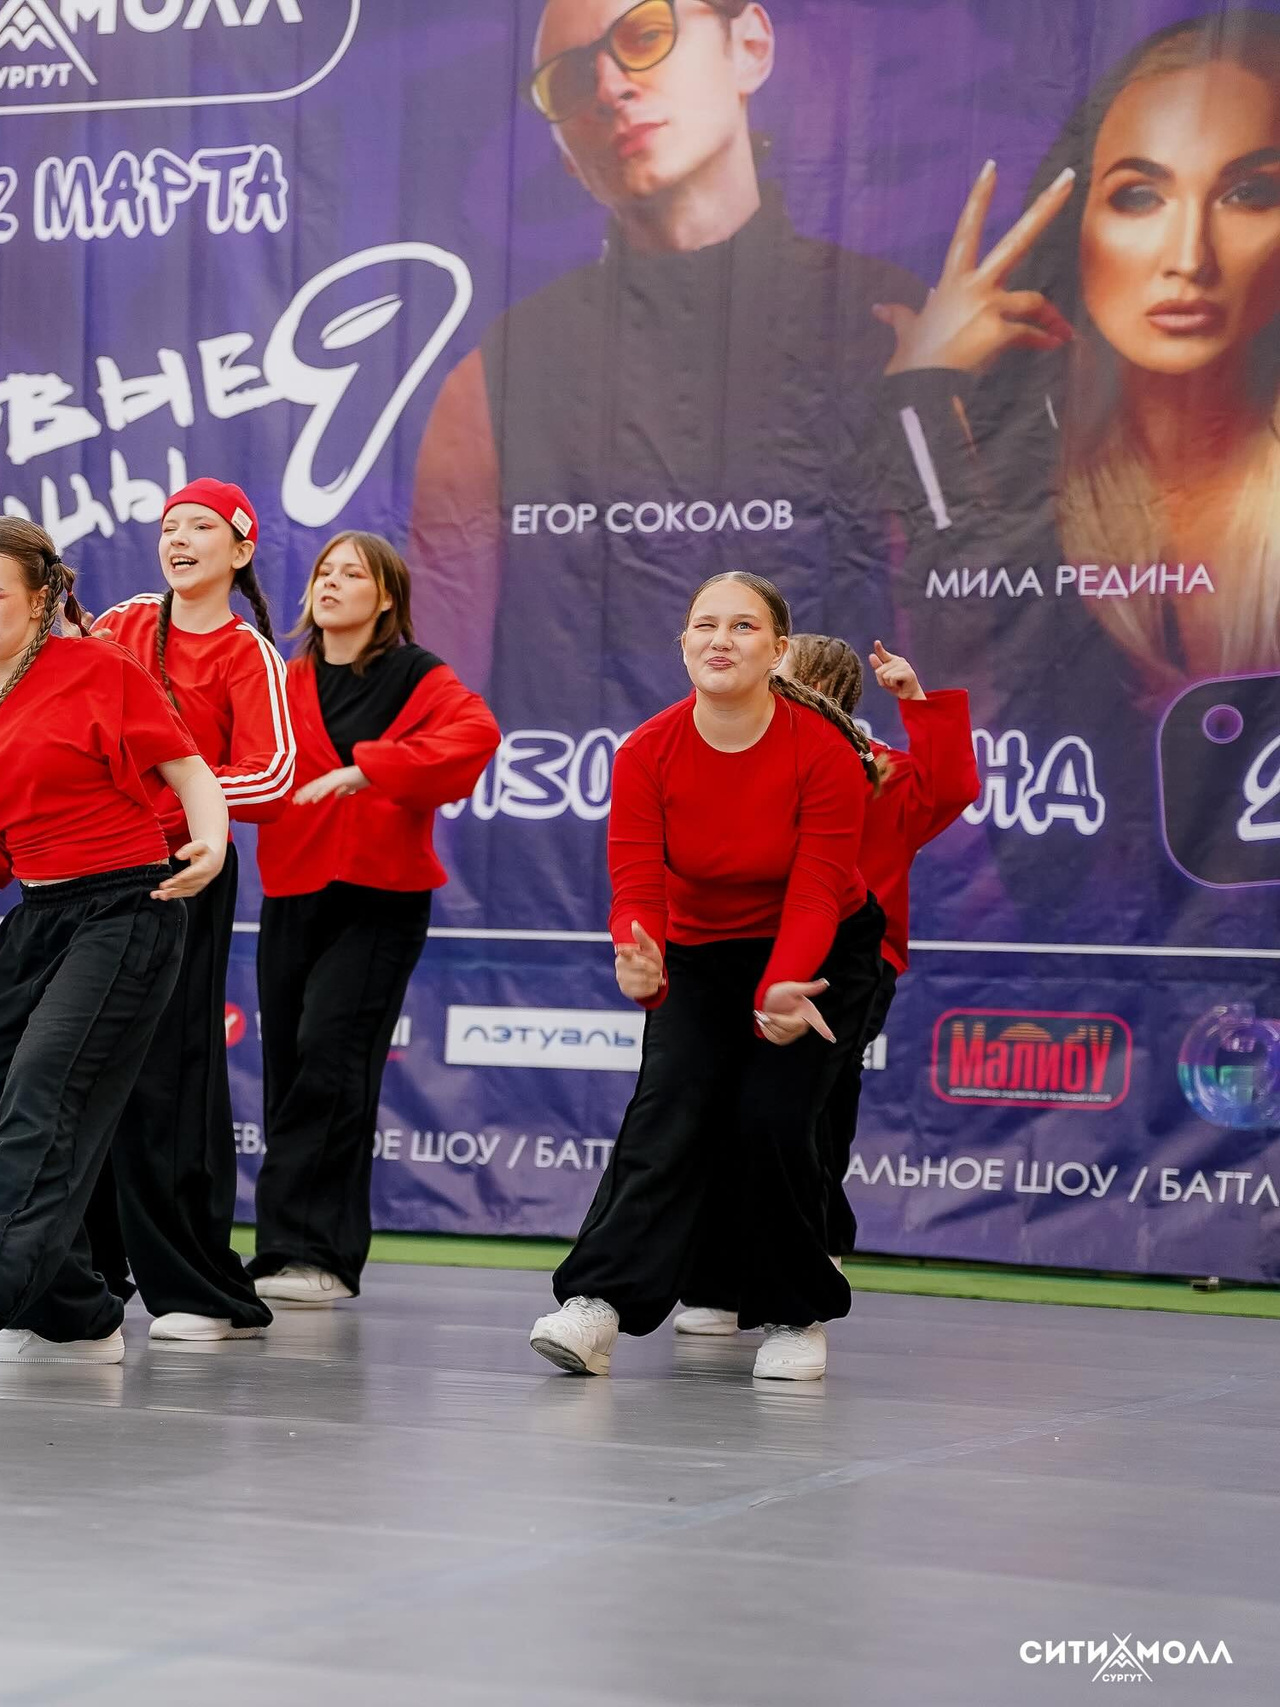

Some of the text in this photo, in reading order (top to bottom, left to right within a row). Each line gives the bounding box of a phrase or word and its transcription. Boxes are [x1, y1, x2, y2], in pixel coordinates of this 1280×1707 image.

[33, 145, 289, 242] МАРТА
[511, 498, 794, 535] ЕГОР СОКОЛОВ
[926, 563, 1216, 600] МИЛА РЕДИНА
[410, 1130, 500, 1166] ШОУ
[1015, 1160, 1119, 1199] ШОУ
